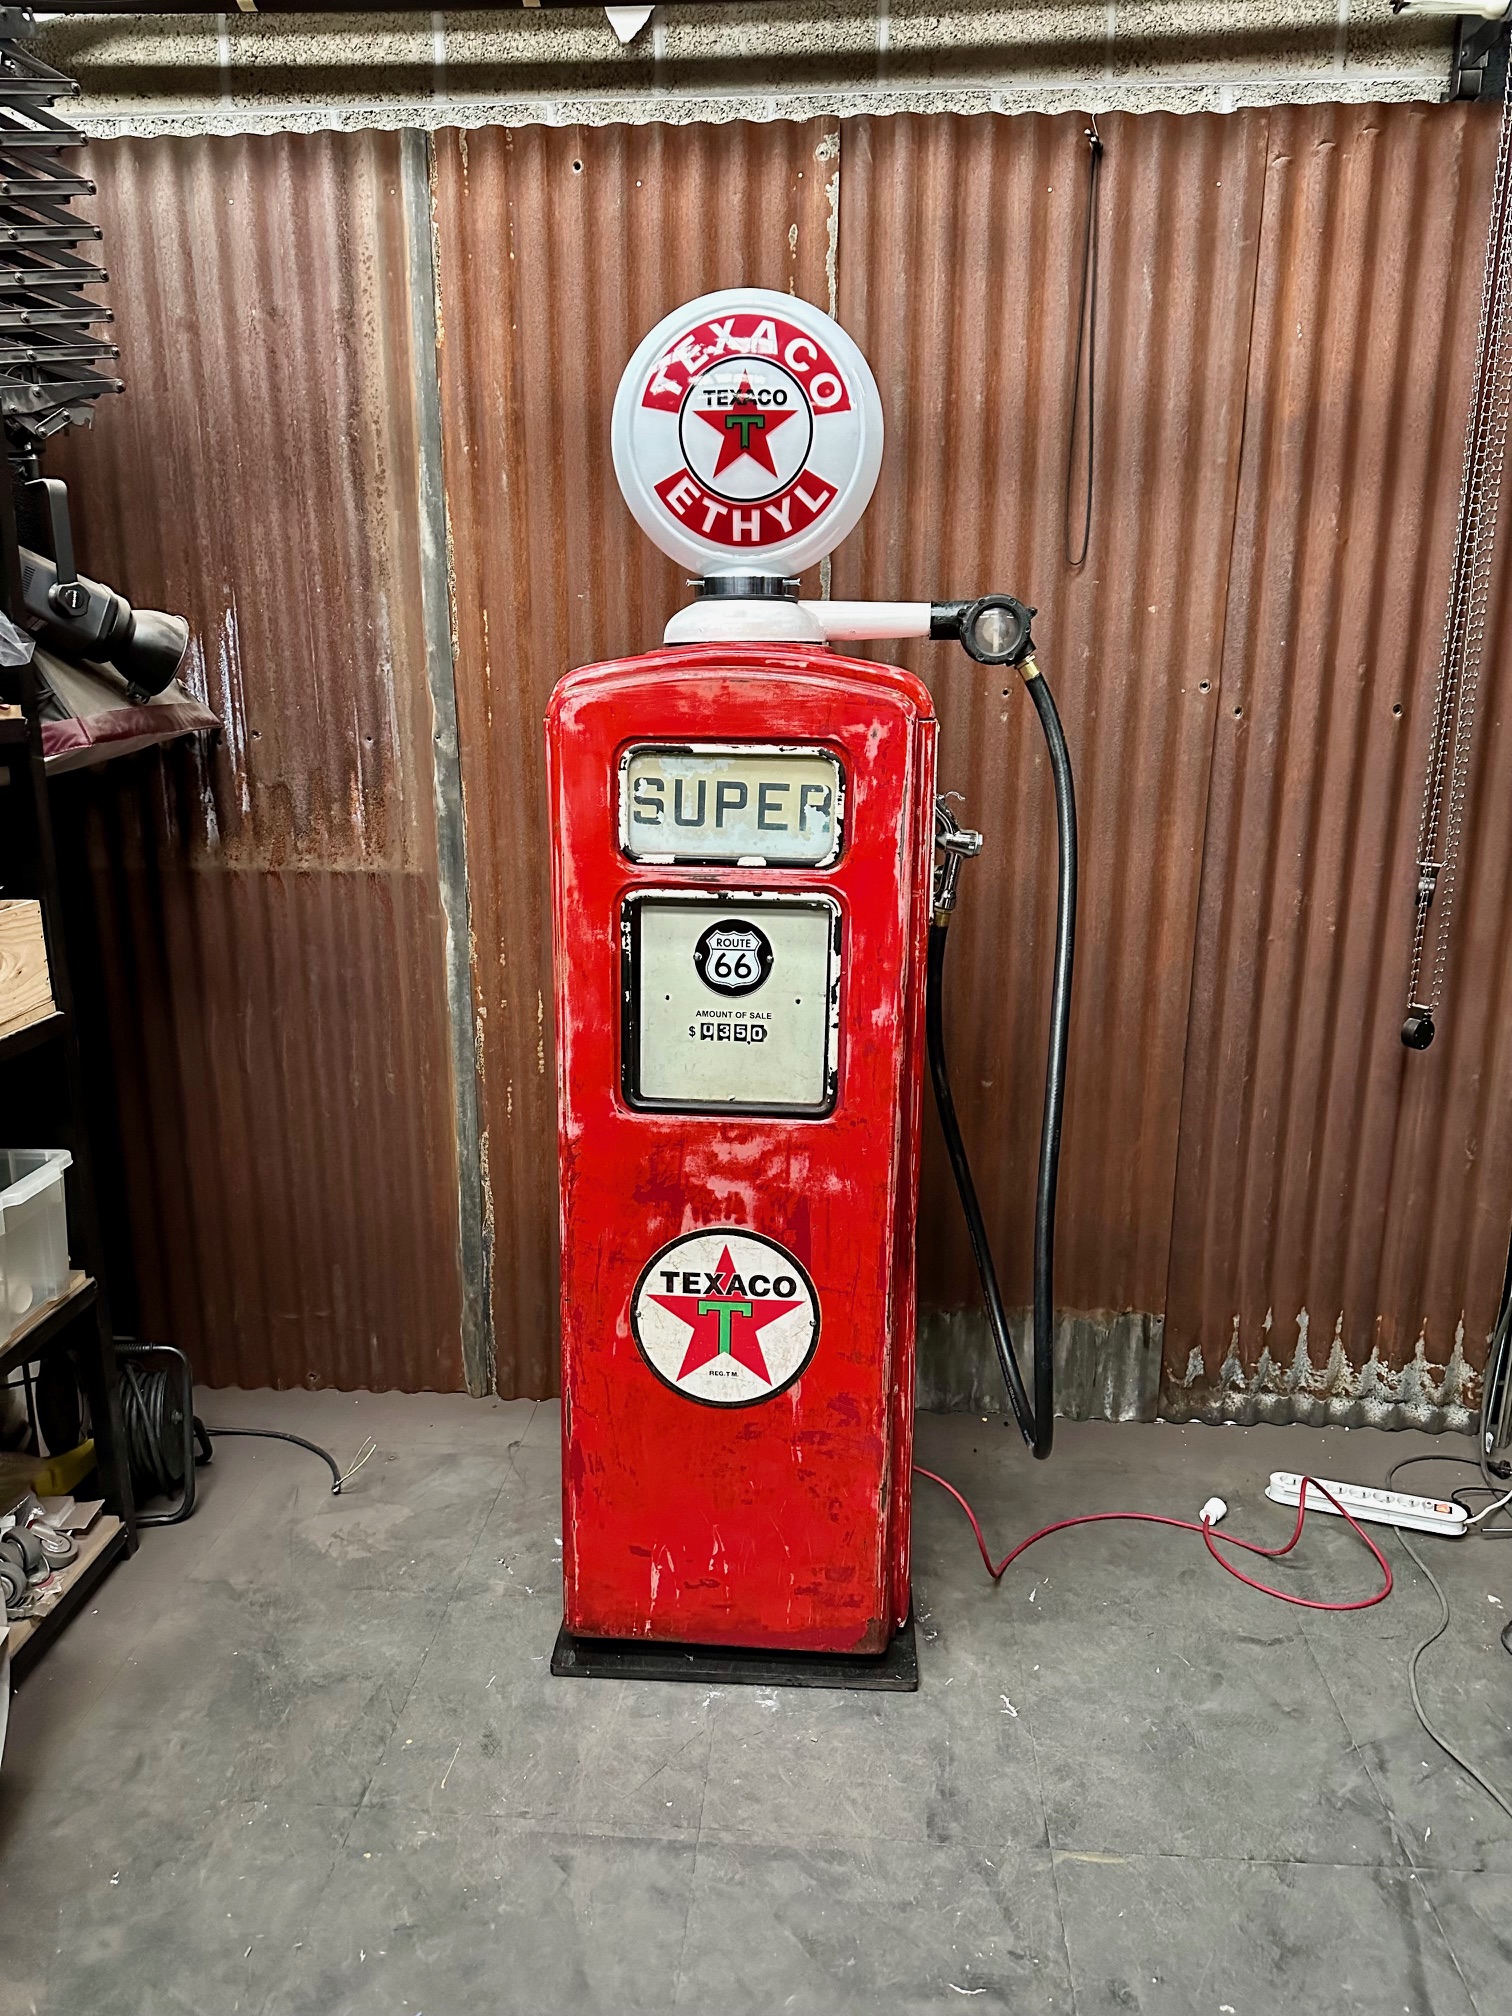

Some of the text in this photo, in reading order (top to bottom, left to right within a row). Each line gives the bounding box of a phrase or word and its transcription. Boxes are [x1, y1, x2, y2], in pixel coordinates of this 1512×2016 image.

[650, 318, 843, 408] TEXACO
[703, 389, 788, 406] TEXACO
[725, 415, 765, 449] T
[666, 476, 830, 542] ETHYL
[633, 777, 832, 833] SUPER
[716, 938, 751, 948] ROUTE
[714, 953, 752, 978] 66
[696, 1010, 733, 1018] AMOUNT
[660, 1271, 797, 1298] TEXACO
[697, 1300, 753, 1355] T
